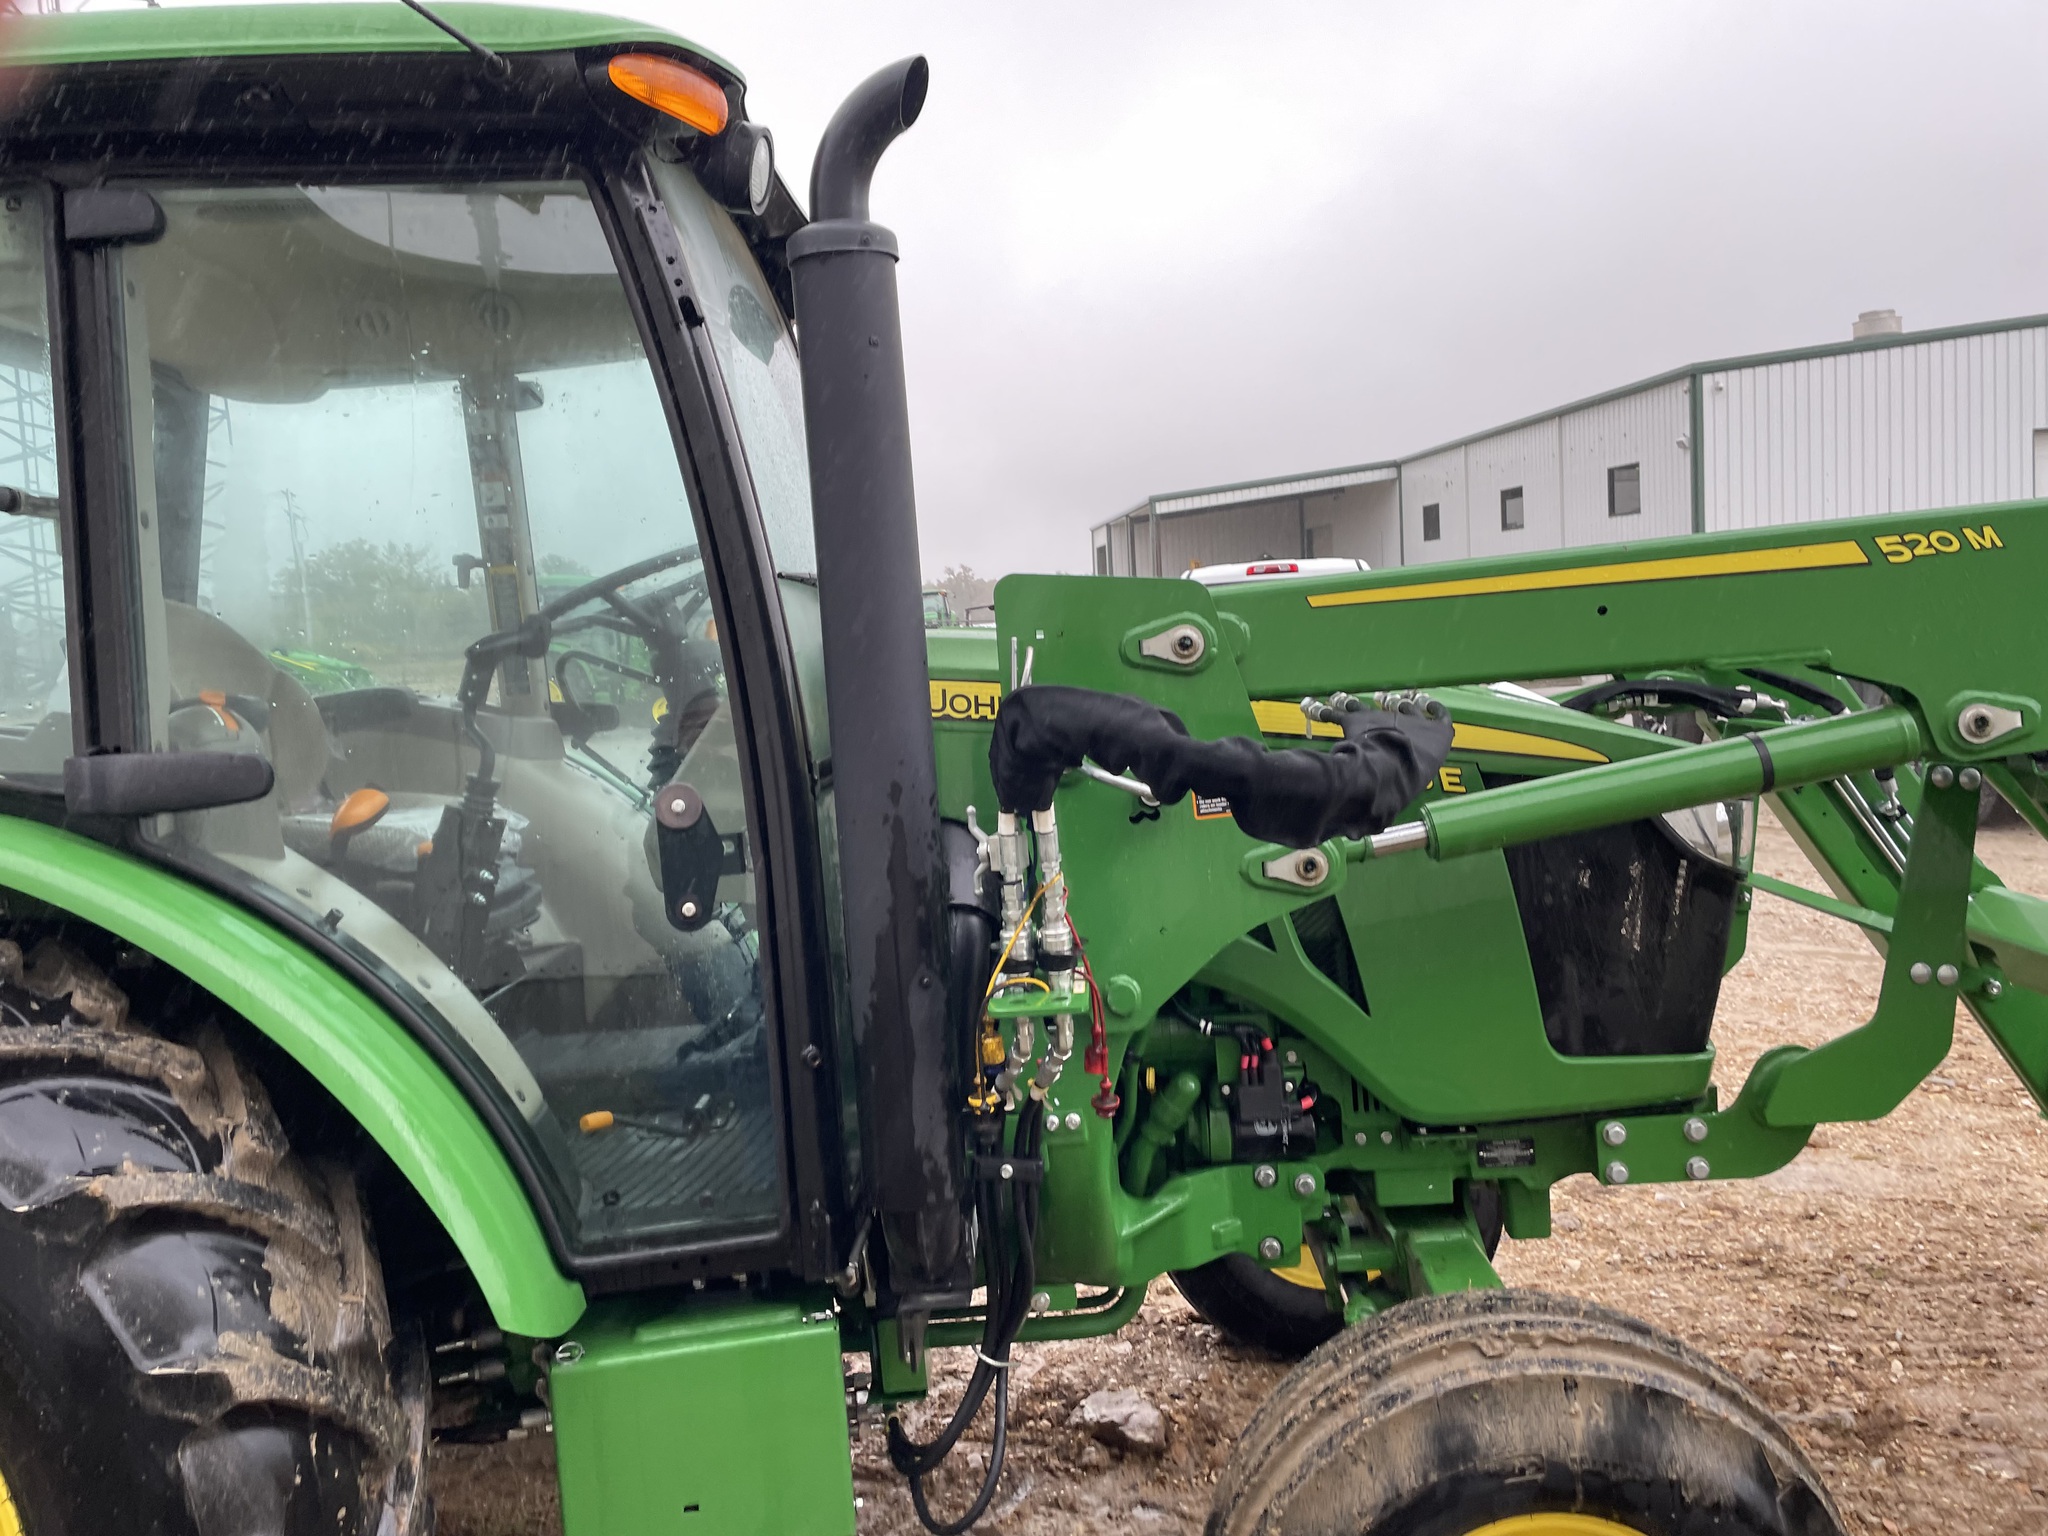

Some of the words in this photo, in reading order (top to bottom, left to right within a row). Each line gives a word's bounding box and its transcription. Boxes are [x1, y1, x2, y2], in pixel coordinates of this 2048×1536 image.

[1874, 529, 1961, 564] 520
[1961, 525, 2004, 551] M
[931, 688, 1001, 715] JOH
